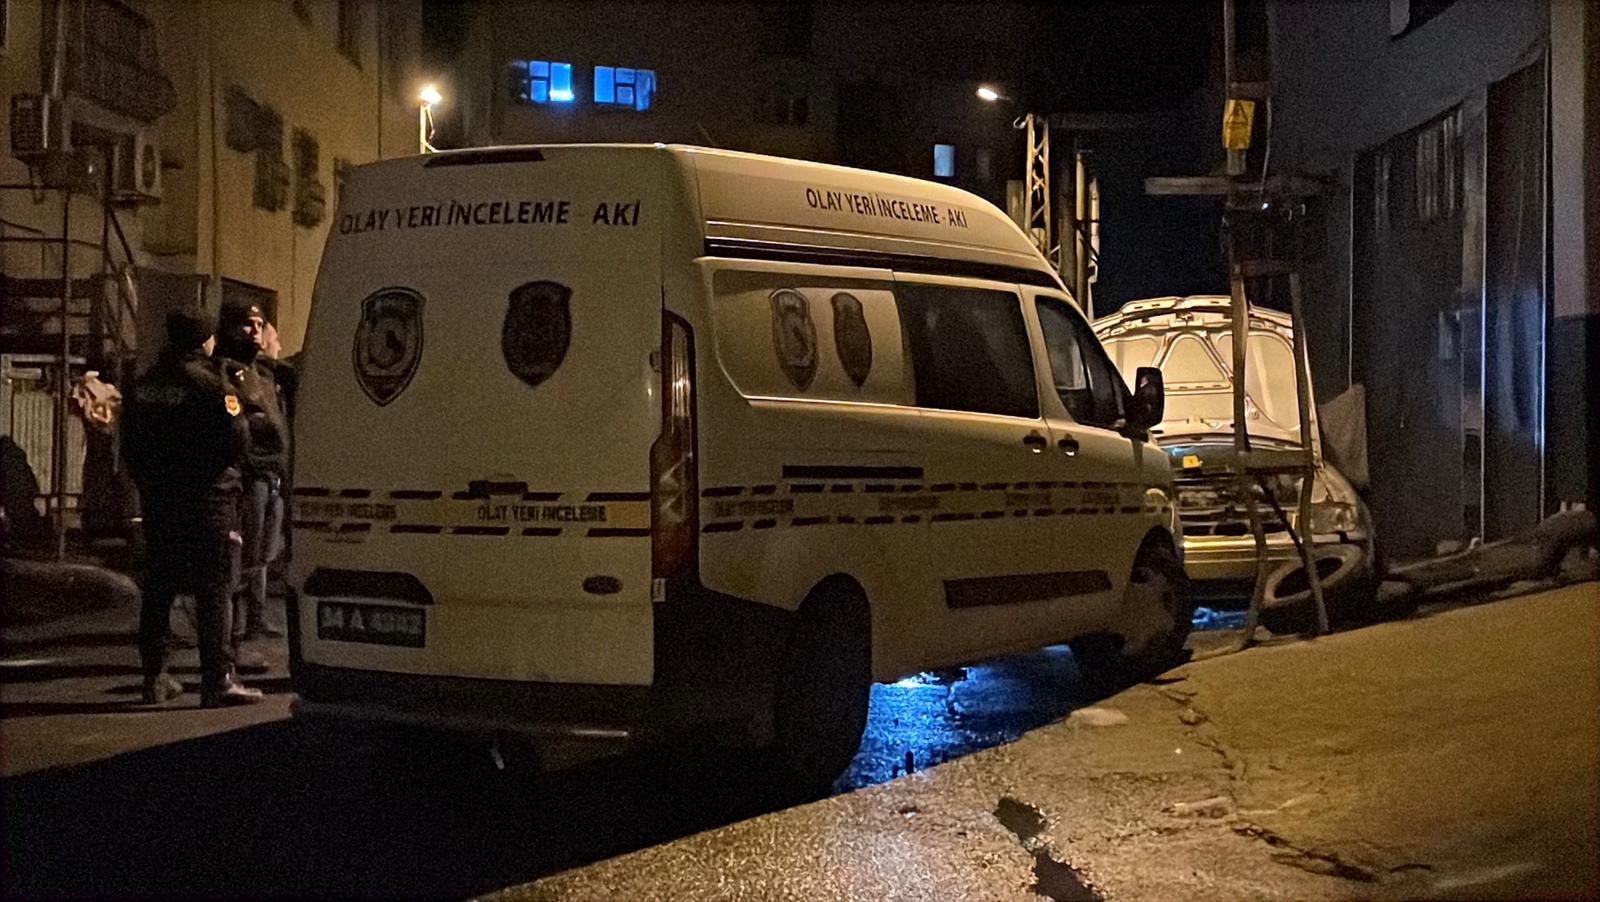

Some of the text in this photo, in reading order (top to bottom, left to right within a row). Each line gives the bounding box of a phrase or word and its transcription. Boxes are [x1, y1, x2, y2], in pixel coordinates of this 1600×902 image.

[340, 208, 390, 235] OLAY
[447, 199, 571, 225] İNCELEME
[806, 188, 843, 212] OLAY
[875, 193, 941, 224] İNCELEME
